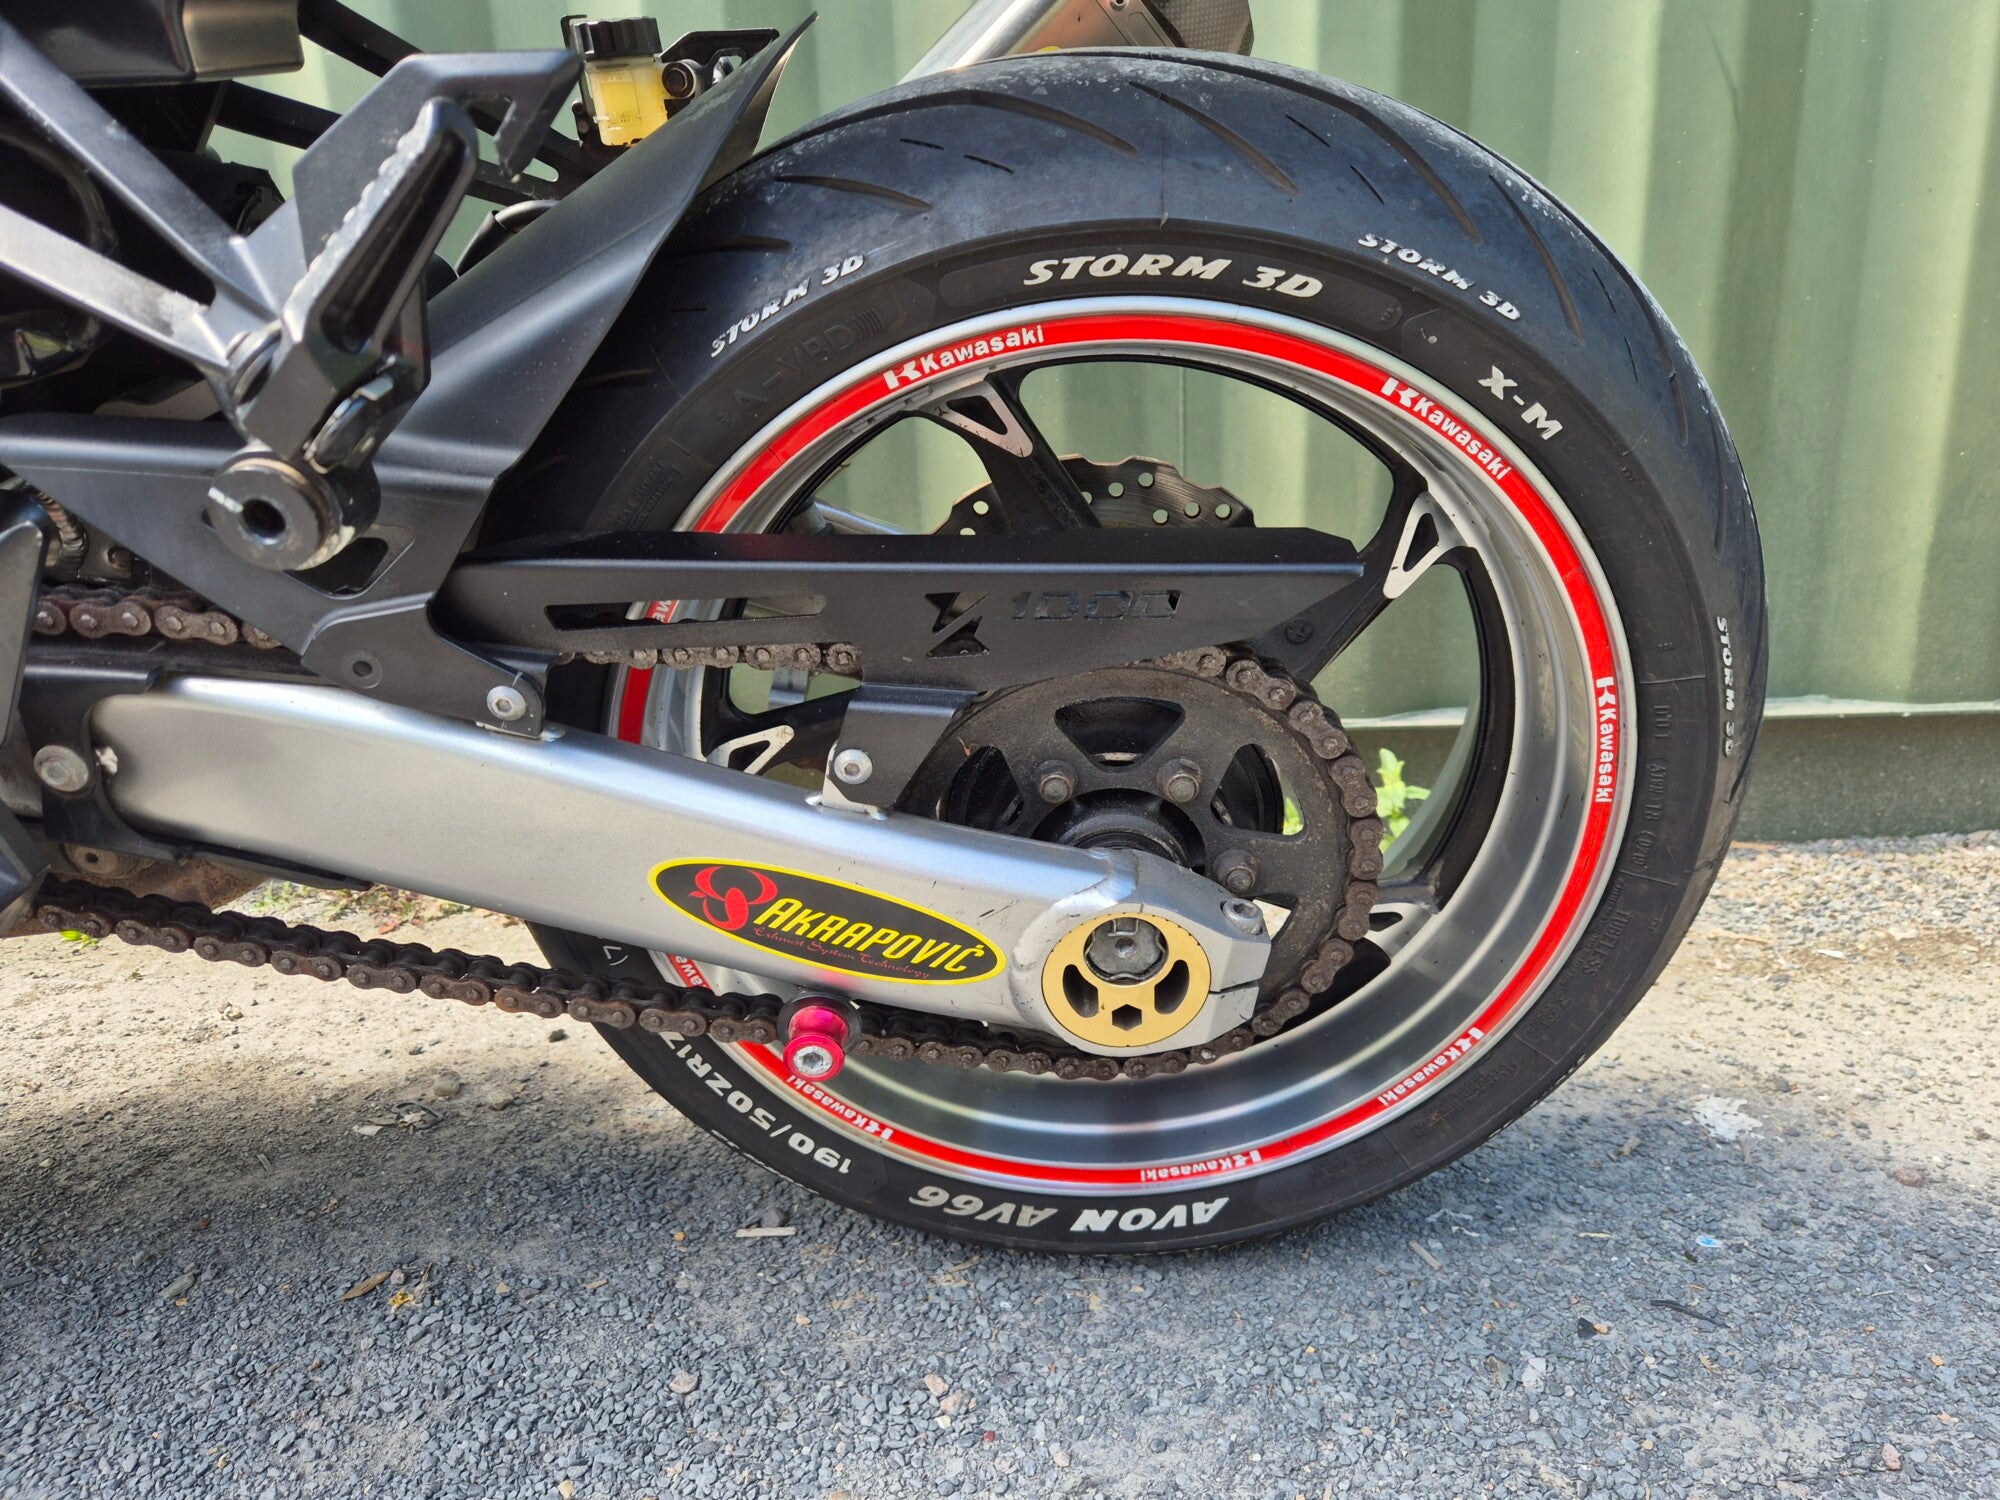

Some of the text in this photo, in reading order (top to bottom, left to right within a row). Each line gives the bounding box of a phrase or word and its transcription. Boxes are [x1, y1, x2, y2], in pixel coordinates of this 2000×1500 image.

[710, 254, 864, 358] STORM 3D
[1023, 253, 1324, 298] STORM 3D
[1357, 233, 1522, 321] STORM 3D
[919, 324, 1045, 376] Kawasaki
[1478, 364, 1563, 442] X-M
[1412, 394, 1512, 481] Kawasaki
[1716, 615, 1735, 712] STORM
[1595, 705, 1618, 804] Kawasaki
[806, 940, 855, 960] System
[785, 1074, 874, 1131] Kawasaki
[1377, 1046, 1462, 1107] Kawasaki
[1139, 1154, 1234, 1183] Kawasaki
[907, 1185, 1231, 1234] AVON AV66
